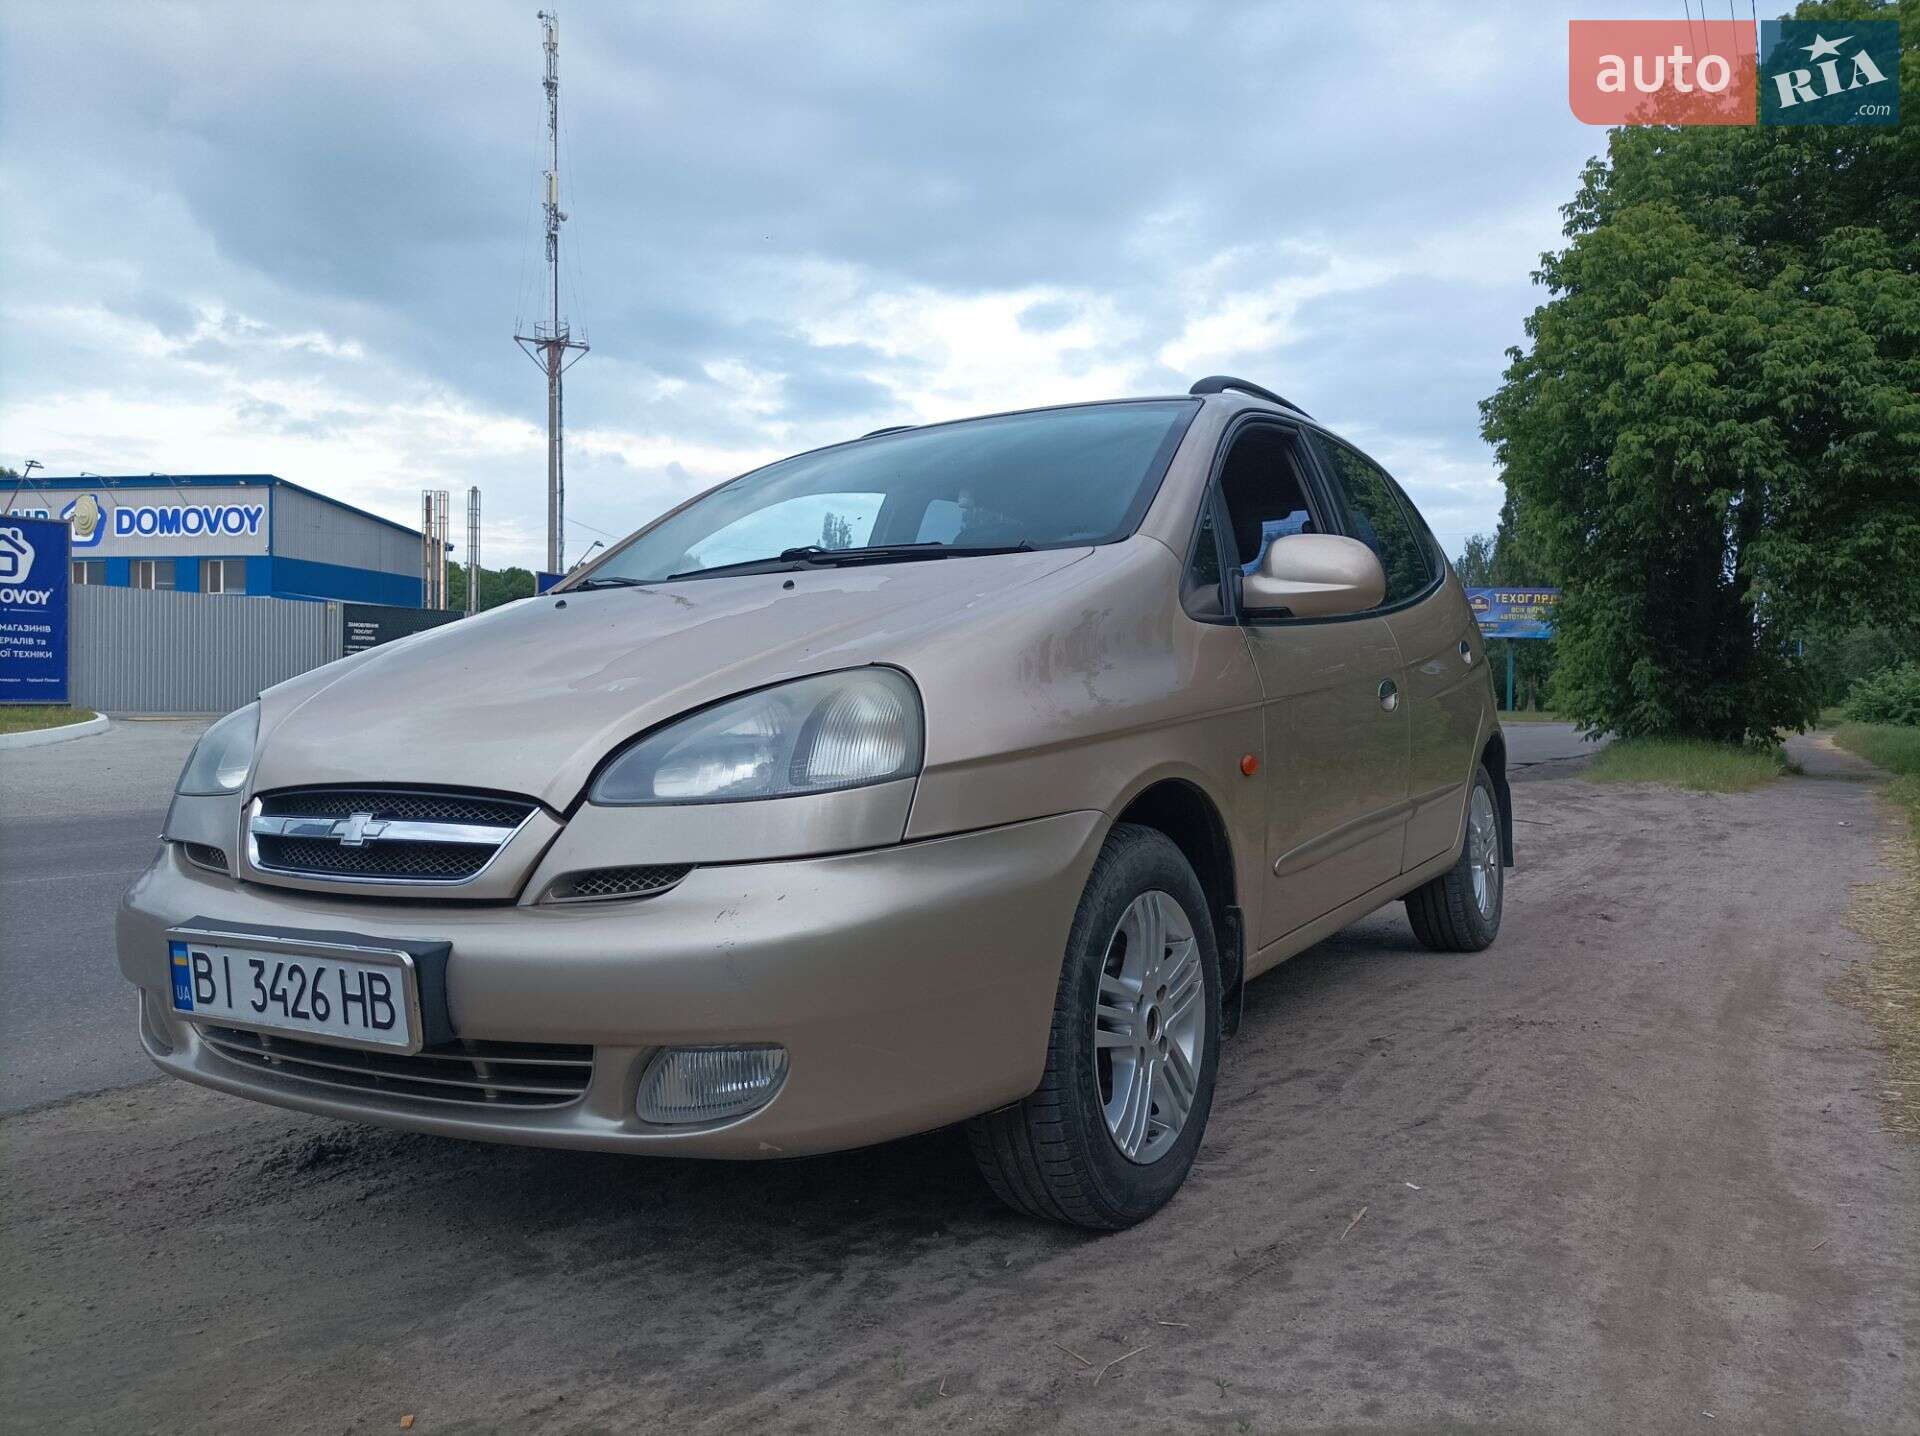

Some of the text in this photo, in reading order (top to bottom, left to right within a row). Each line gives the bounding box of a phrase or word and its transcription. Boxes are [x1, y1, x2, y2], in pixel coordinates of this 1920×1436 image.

[115, 506, 264, 536] DOMOVOY
[12, 650, 53, 659] ТЕХНІКИ
[176, 985, 191, 1001] UA
[192, 951, 396, 1030] BI 3426 HB
